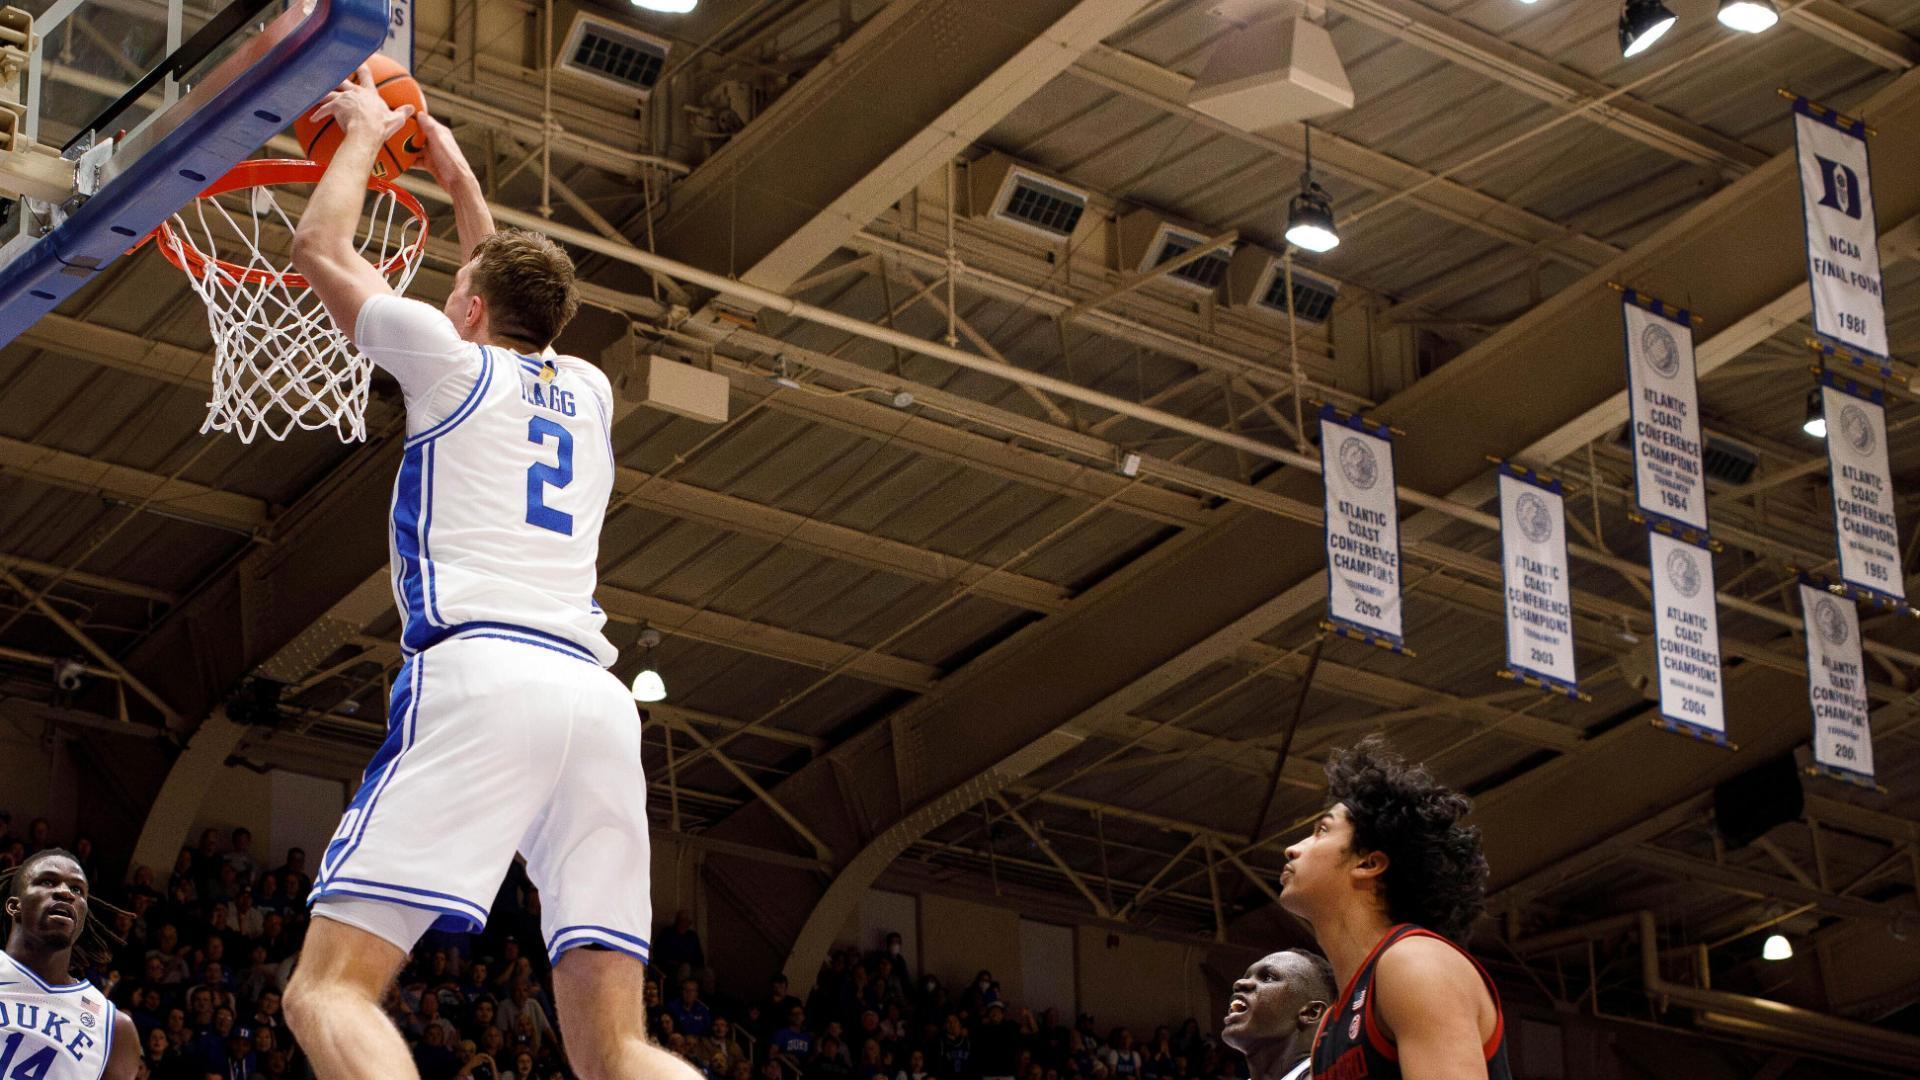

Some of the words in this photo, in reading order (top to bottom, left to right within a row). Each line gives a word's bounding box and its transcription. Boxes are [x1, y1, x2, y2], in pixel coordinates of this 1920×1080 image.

[1828, 234, 1862, 261] NCAA
[1813, 258, 1849, 285] FINAL
[1644, 387, 1687, 417] ATLANTIC
[1651, 409, 1682, 432] COAST
[1637, 421, 1699, 458] CONFERENCE
[1642, 442, 1699, 476] CHAMPIONS
[526, 415, 574, 537] 2
[1339, 500, 1387, 527] ATLANTIC
[1661, 490, 1688, 512] 1964
[1348, 521, 1380, 542] COAST
[1330, 534, 1396, 567] CONFERENCE
[1334, 554, 1394, 584] CHAMPIONS
[1516, 555, 1560, 580] ATLANTIC
[1524, 575, 1553, 595] COAST
[1509, 587, 1568, 618] CONFERENCE
[1512, 606, 1568, 634] CHAMPIONS
[1667, 606, 1708, 630] ATLANTIC
[1675, 626, 1702, 646] COAST
[1660, 638, 1719, 668] CONFERENCE
[1664, 656, 1717, 683] CHAMPIONS
[1682, 697, 1706, 716] 2004
[0, 1032, 59, 1080] 14
